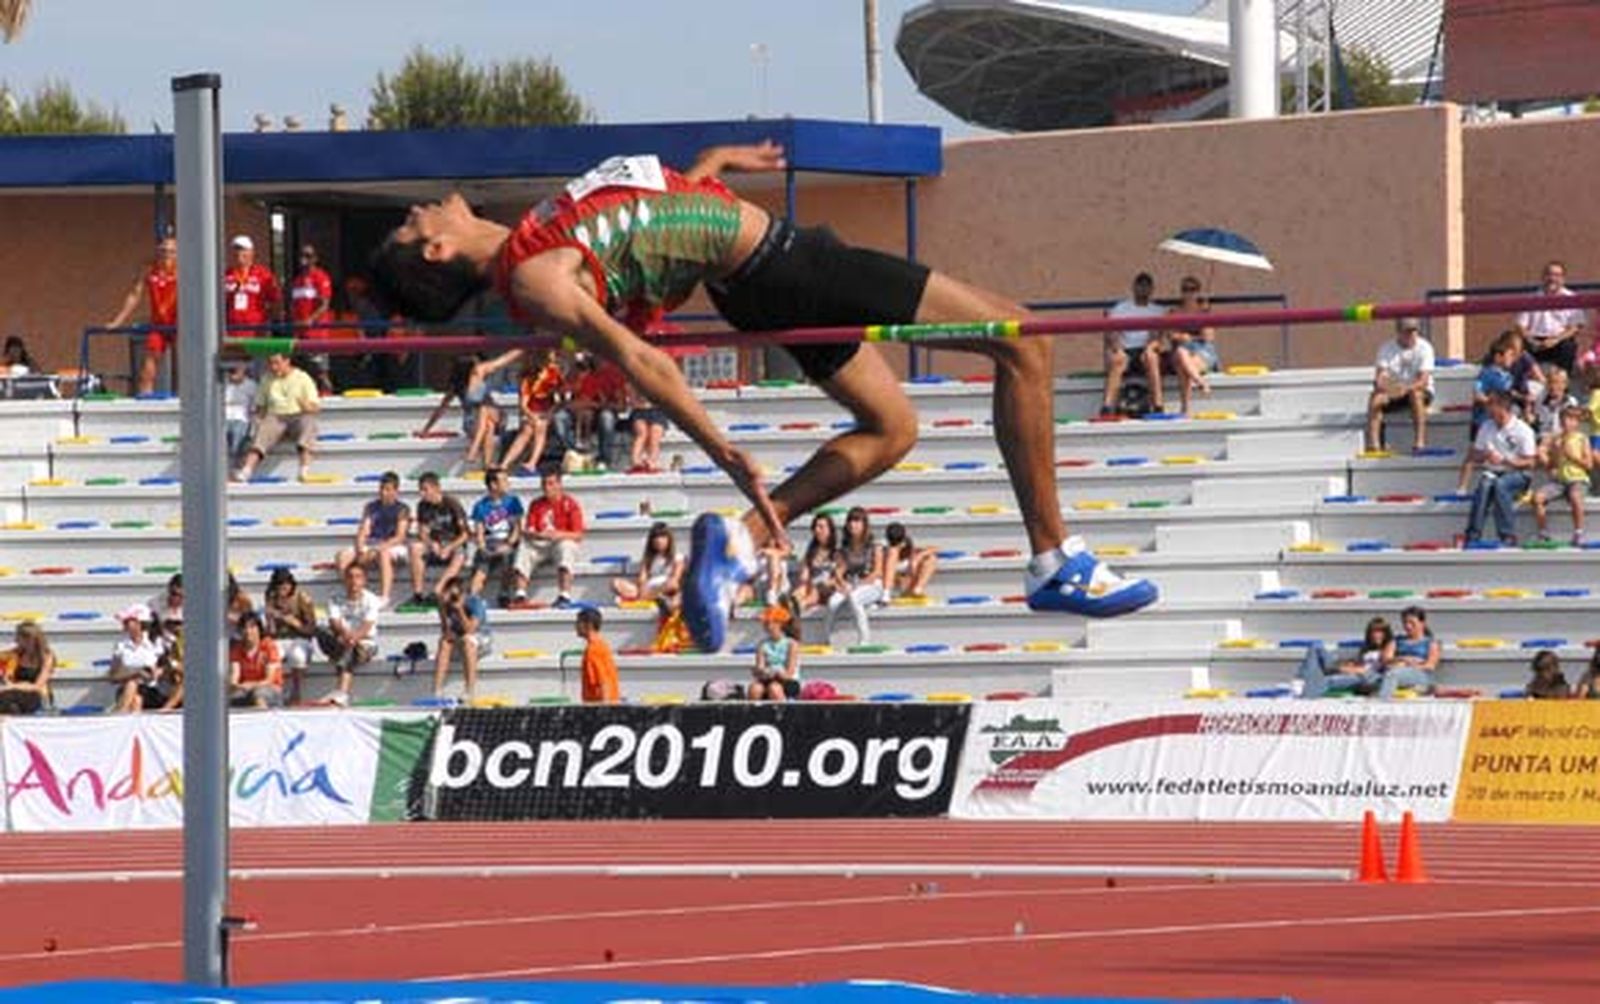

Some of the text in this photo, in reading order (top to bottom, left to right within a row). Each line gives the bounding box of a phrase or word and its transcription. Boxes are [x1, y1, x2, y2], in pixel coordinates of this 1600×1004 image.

[430, 723, 949, 800] bcn2010.org
[1471, 753, 1552, 774] PUNTA
[1086, 776, 1449, 799] www.fedatletismoandaluz.net
